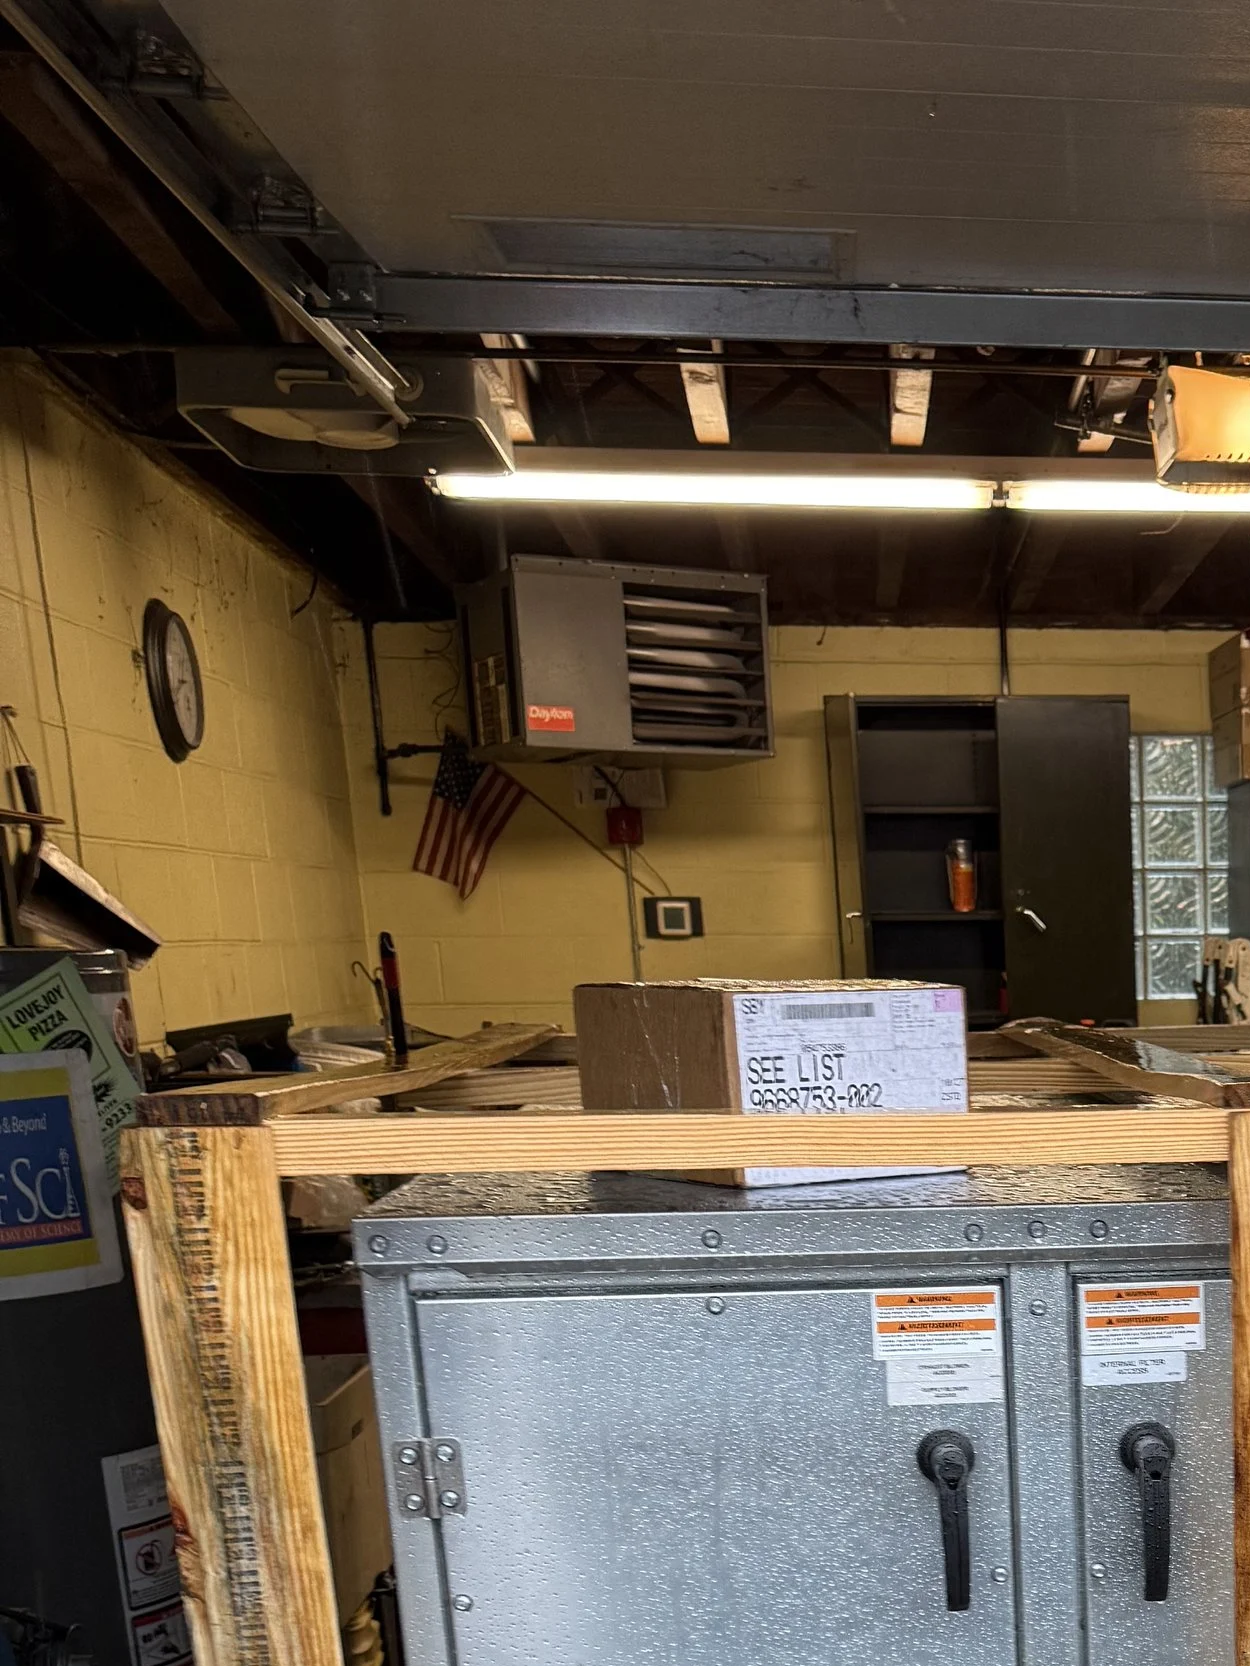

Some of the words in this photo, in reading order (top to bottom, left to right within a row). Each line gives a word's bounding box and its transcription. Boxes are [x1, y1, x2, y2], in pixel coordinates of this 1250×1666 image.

[529, 705, 574, 722] Dayton
[6, 984, 65, 1029] LOVEJOY
[28, 1009, 69, 1041] PIZZA
[747, 1055, 787, 1085] SEE
[798, 1053, 846, 1082] LIST
[11, 1113, 47, 1136] Beyond
